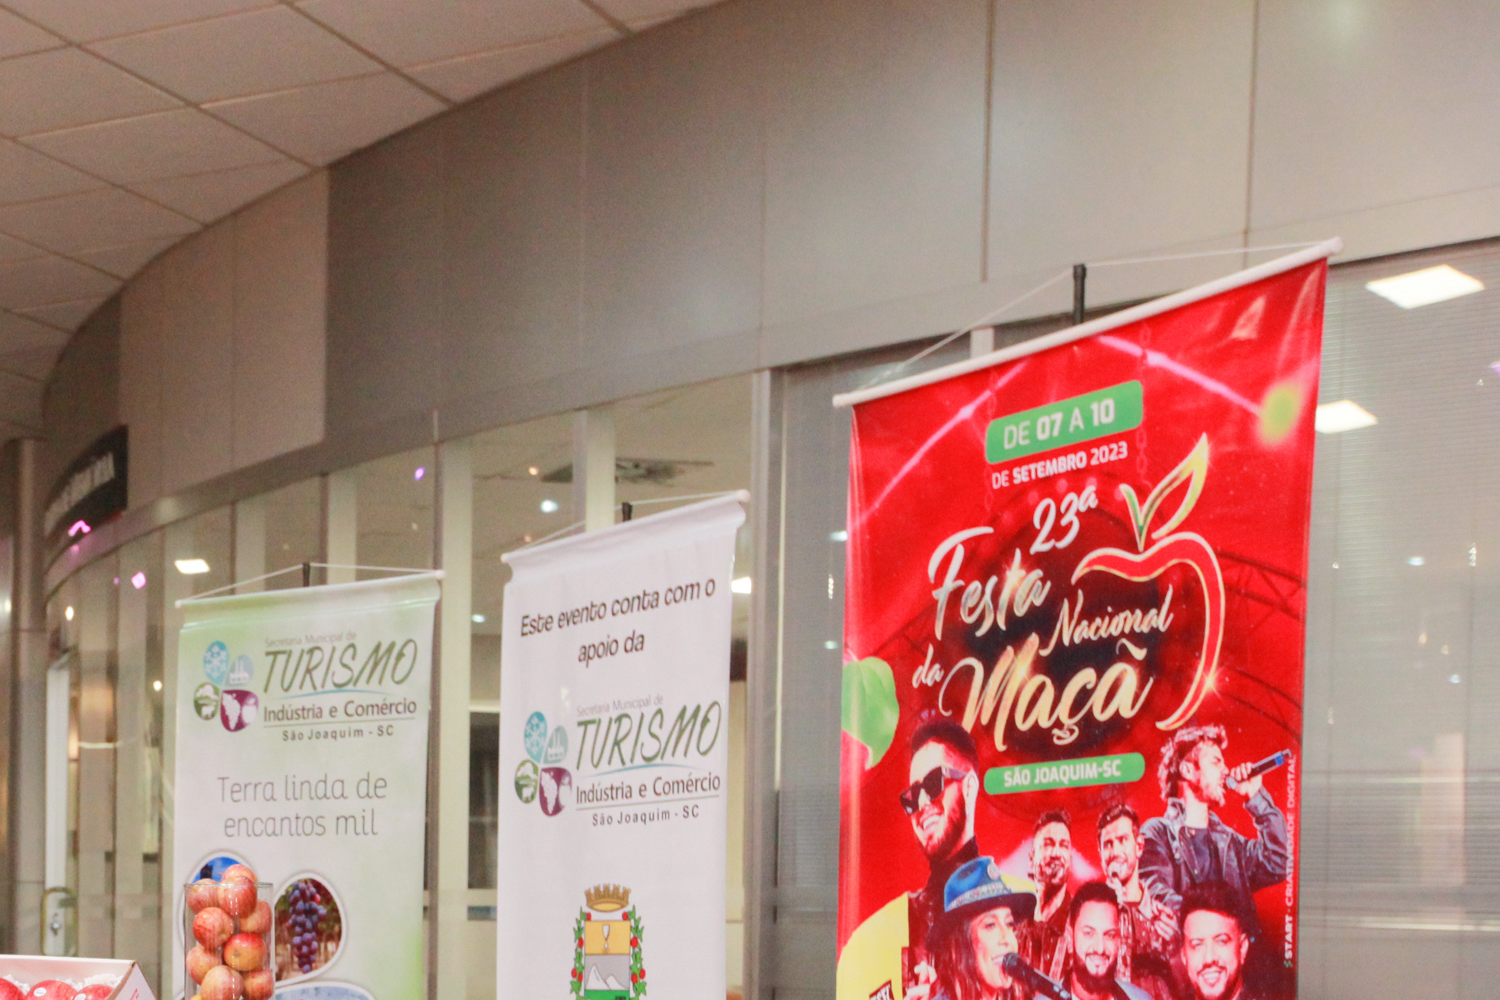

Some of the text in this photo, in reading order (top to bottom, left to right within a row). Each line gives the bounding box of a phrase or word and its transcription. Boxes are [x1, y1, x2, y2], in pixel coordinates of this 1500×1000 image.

[1003, 397, 1115, 450] DE 07 A 10
[992, 440, 1128, 490] DE SETEMBRO 2023
[928, 526, 1052, 640] Festa
[520, 578, 716, 637] Este evento conta com o
[1038, 584, 1175, 656] Nacional
[263, 638, 418, 694] TURISMO
[578, 629, 645, 669] apoio da
[912, 644, 944, 688] da
[263, 697, 417, 723] Indústria e Comércio
[939, 633, 1155, 751] Maçã
[282, 728, 304, 742] São
[307, 725, 364, 742] Joaquim
[377, 724, 394, 738] SC
[576, 700, 722, 771] TURISMO
[217, 772, 388, 803] Terra linda de
[576, 771, 721, 805] Indústria e Comércio
[1003, 758, 1122, 789] SÃO JOAQUIM-SC
[1287, 754, 1297, 808] DIGITAL
[224, 808, 378, 839] encantos mil
[592, 812, 613, 826] São
[617, 809, 671, 826] Joaquim
[683, 804, 700, 819] SC
[1284, 914, 1294, 960] START
